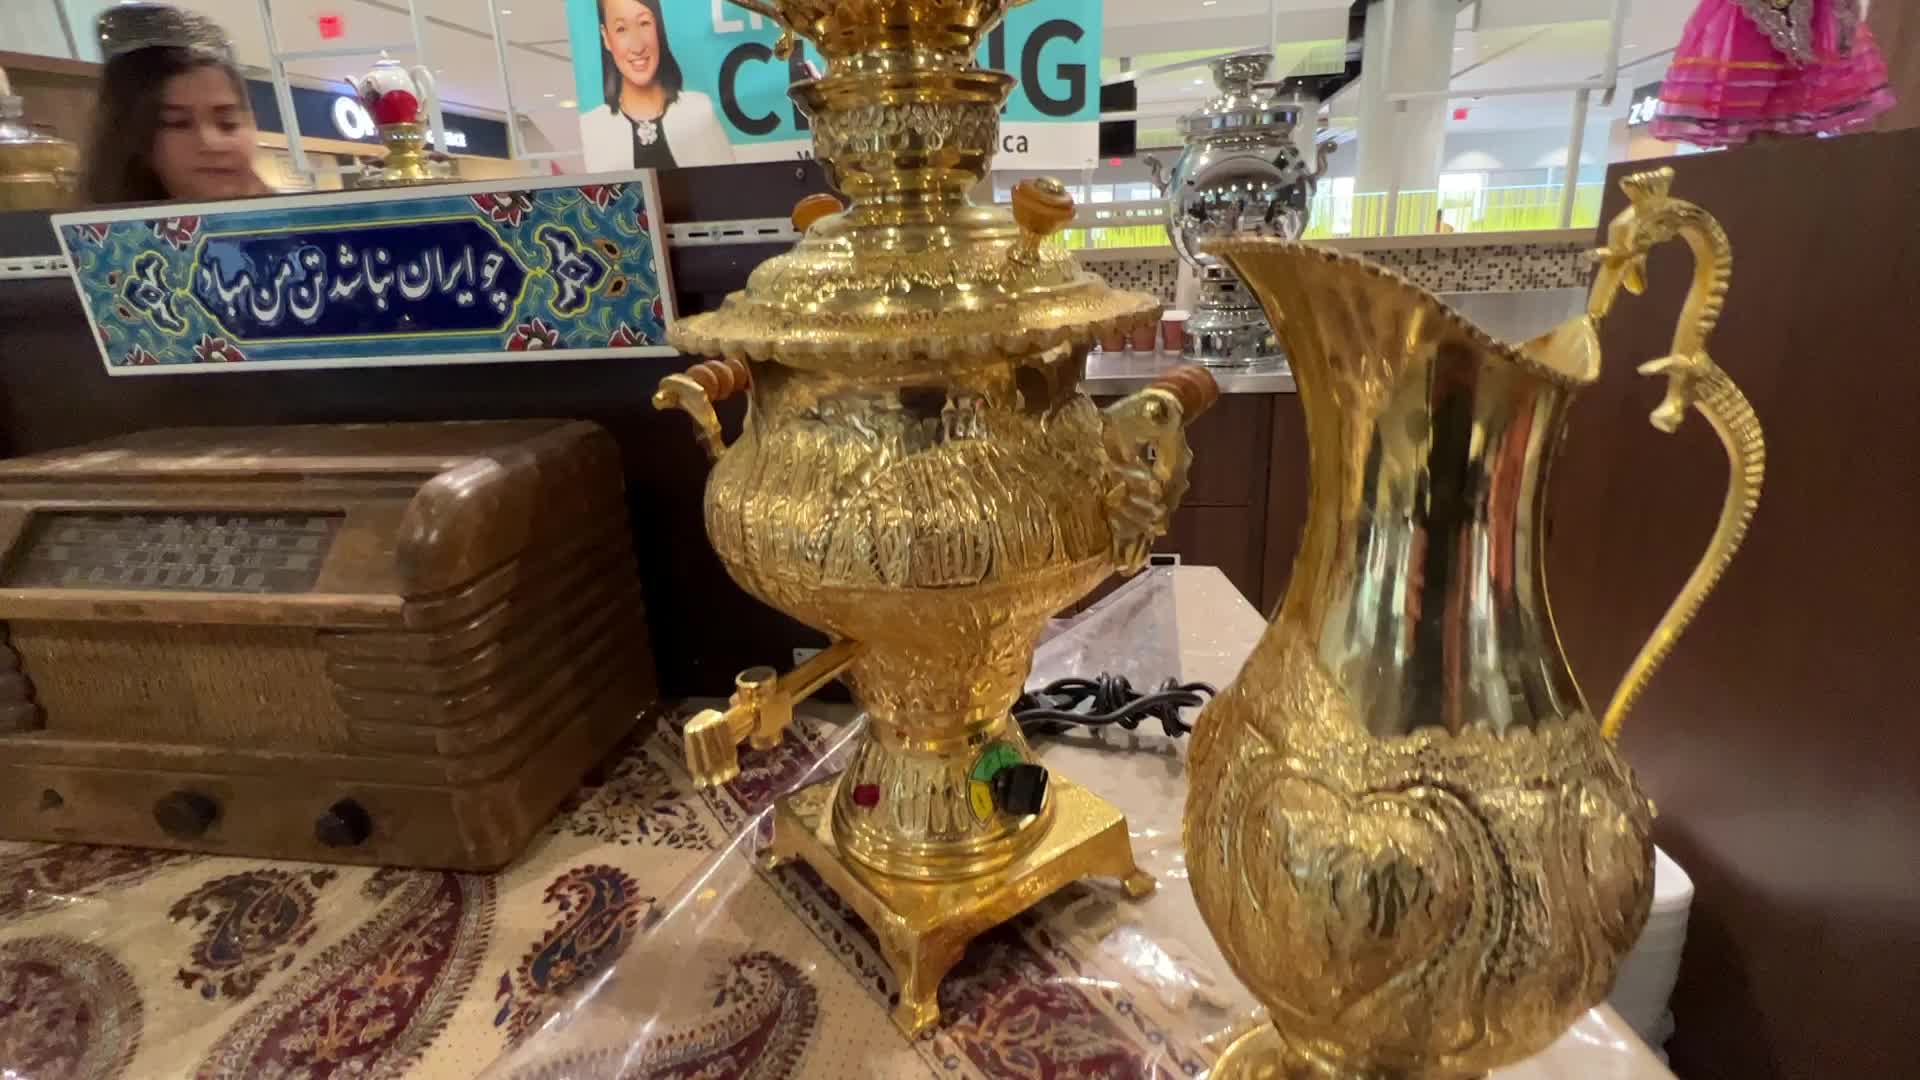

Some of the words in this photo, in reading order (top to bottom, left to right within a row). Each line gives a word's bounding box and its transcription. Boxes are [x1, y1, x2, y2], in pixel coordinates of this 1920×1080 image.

[201, 260, 249, 317] مباد
[251, 261, 293, 321] من
[289, 252, 323, 320] تن
[328, 244, 394, 310] نباشد
[400, 247, 475, 304] ایران
[479, 253, 507, 312] چو
